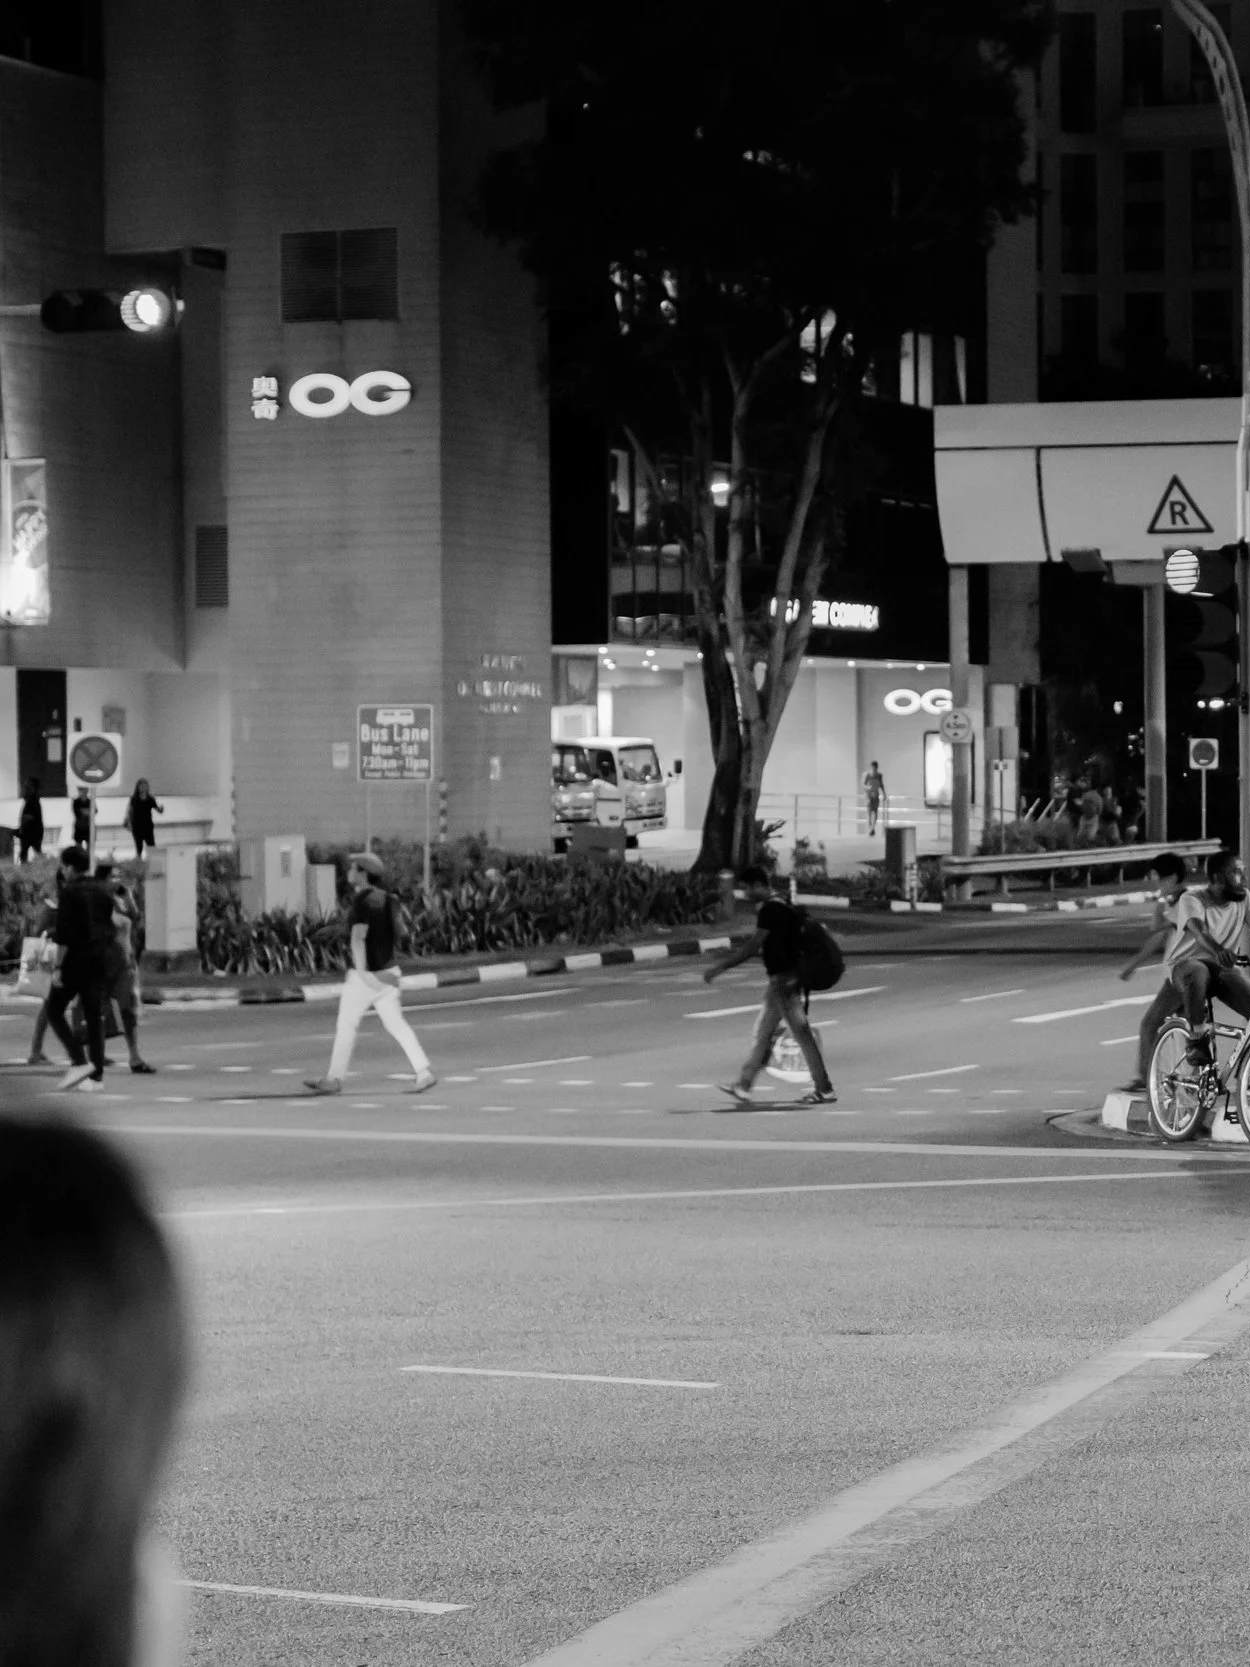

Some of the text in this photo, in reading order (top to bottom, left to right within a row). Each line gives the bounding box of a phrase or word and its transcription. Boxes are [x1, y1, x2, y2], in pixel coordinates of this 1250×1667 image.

[289, 370, 412, 418] OG
[1170, 500, 1188, 525] R
[884, 688, 953, 715] OG
[361, 724, 429, 743] Bus Lane
